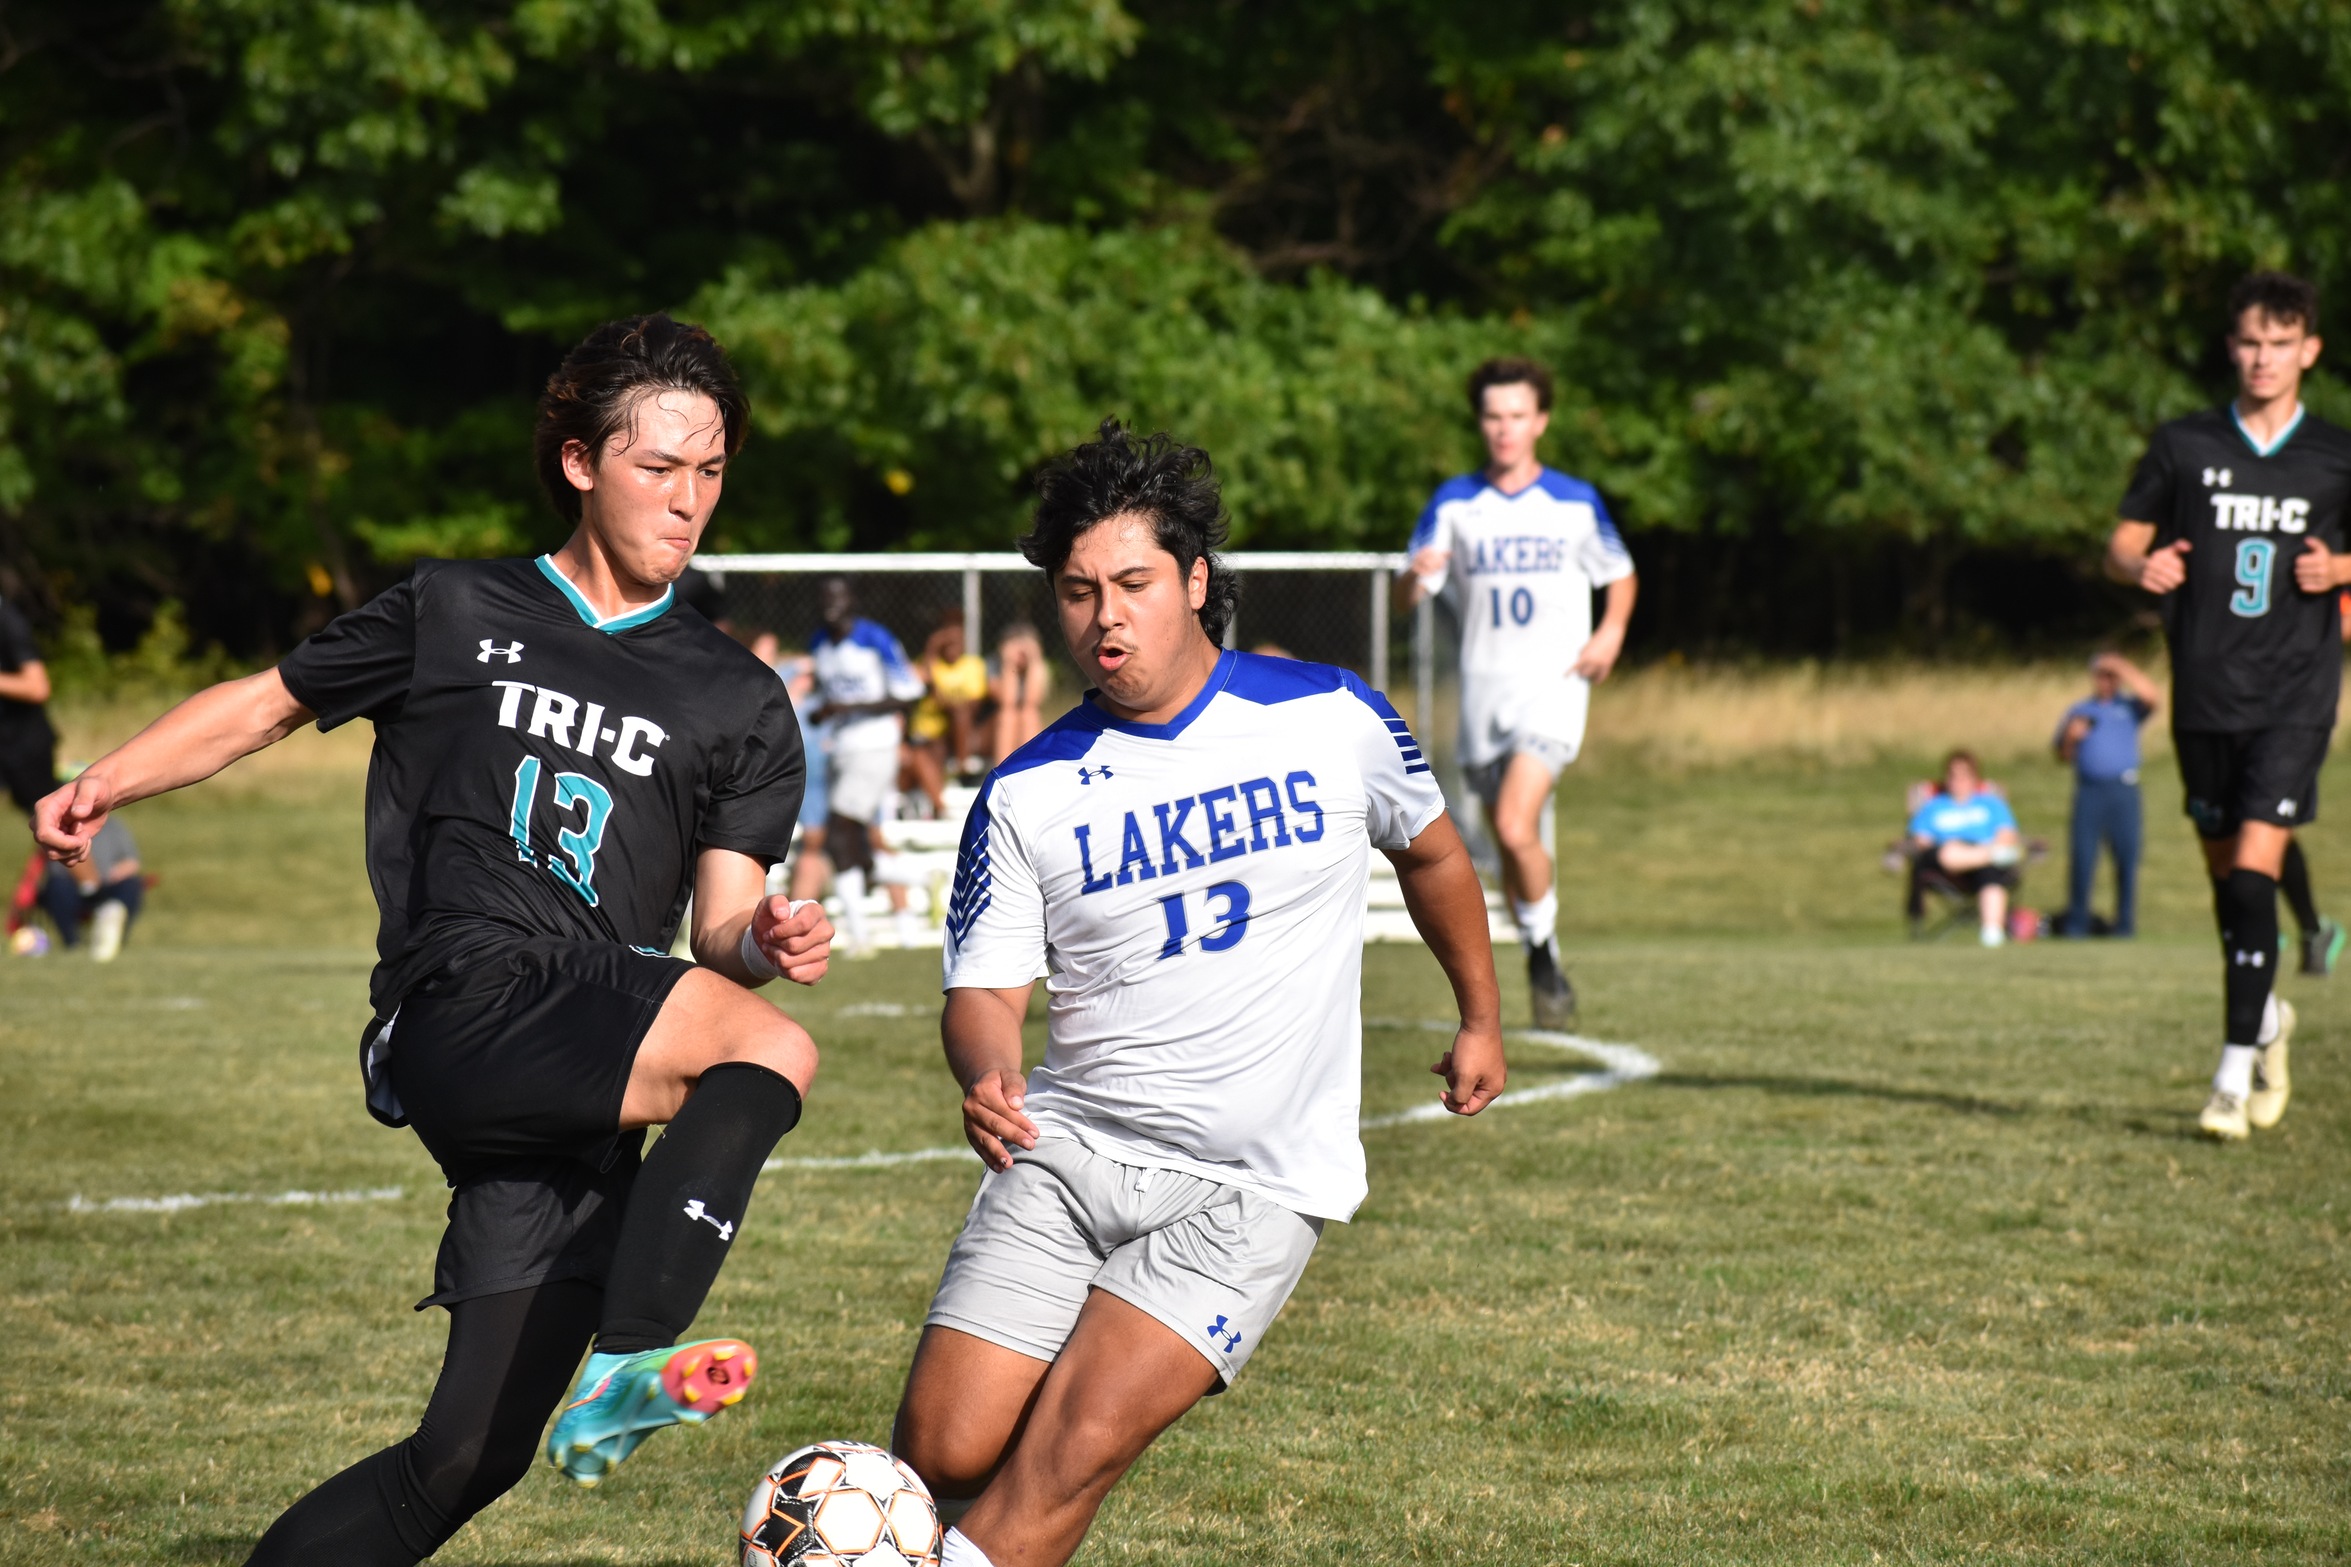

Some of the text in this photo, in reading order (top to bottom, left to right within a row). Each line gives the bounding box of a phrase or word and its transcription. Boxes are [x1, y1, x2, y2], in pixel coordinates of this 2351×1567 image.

[2210, 493, 2310, 533] TRI-C
[1491, 587, 1534, 627] 10
[2230, 537, 2276, 617] 9
[492, 680, 666, 777] TRI-C
[509, 755, 614, 907] 13
[1073, 770, 1324, 895] LAKERS
[1155, 879, 1253, 961] 13
